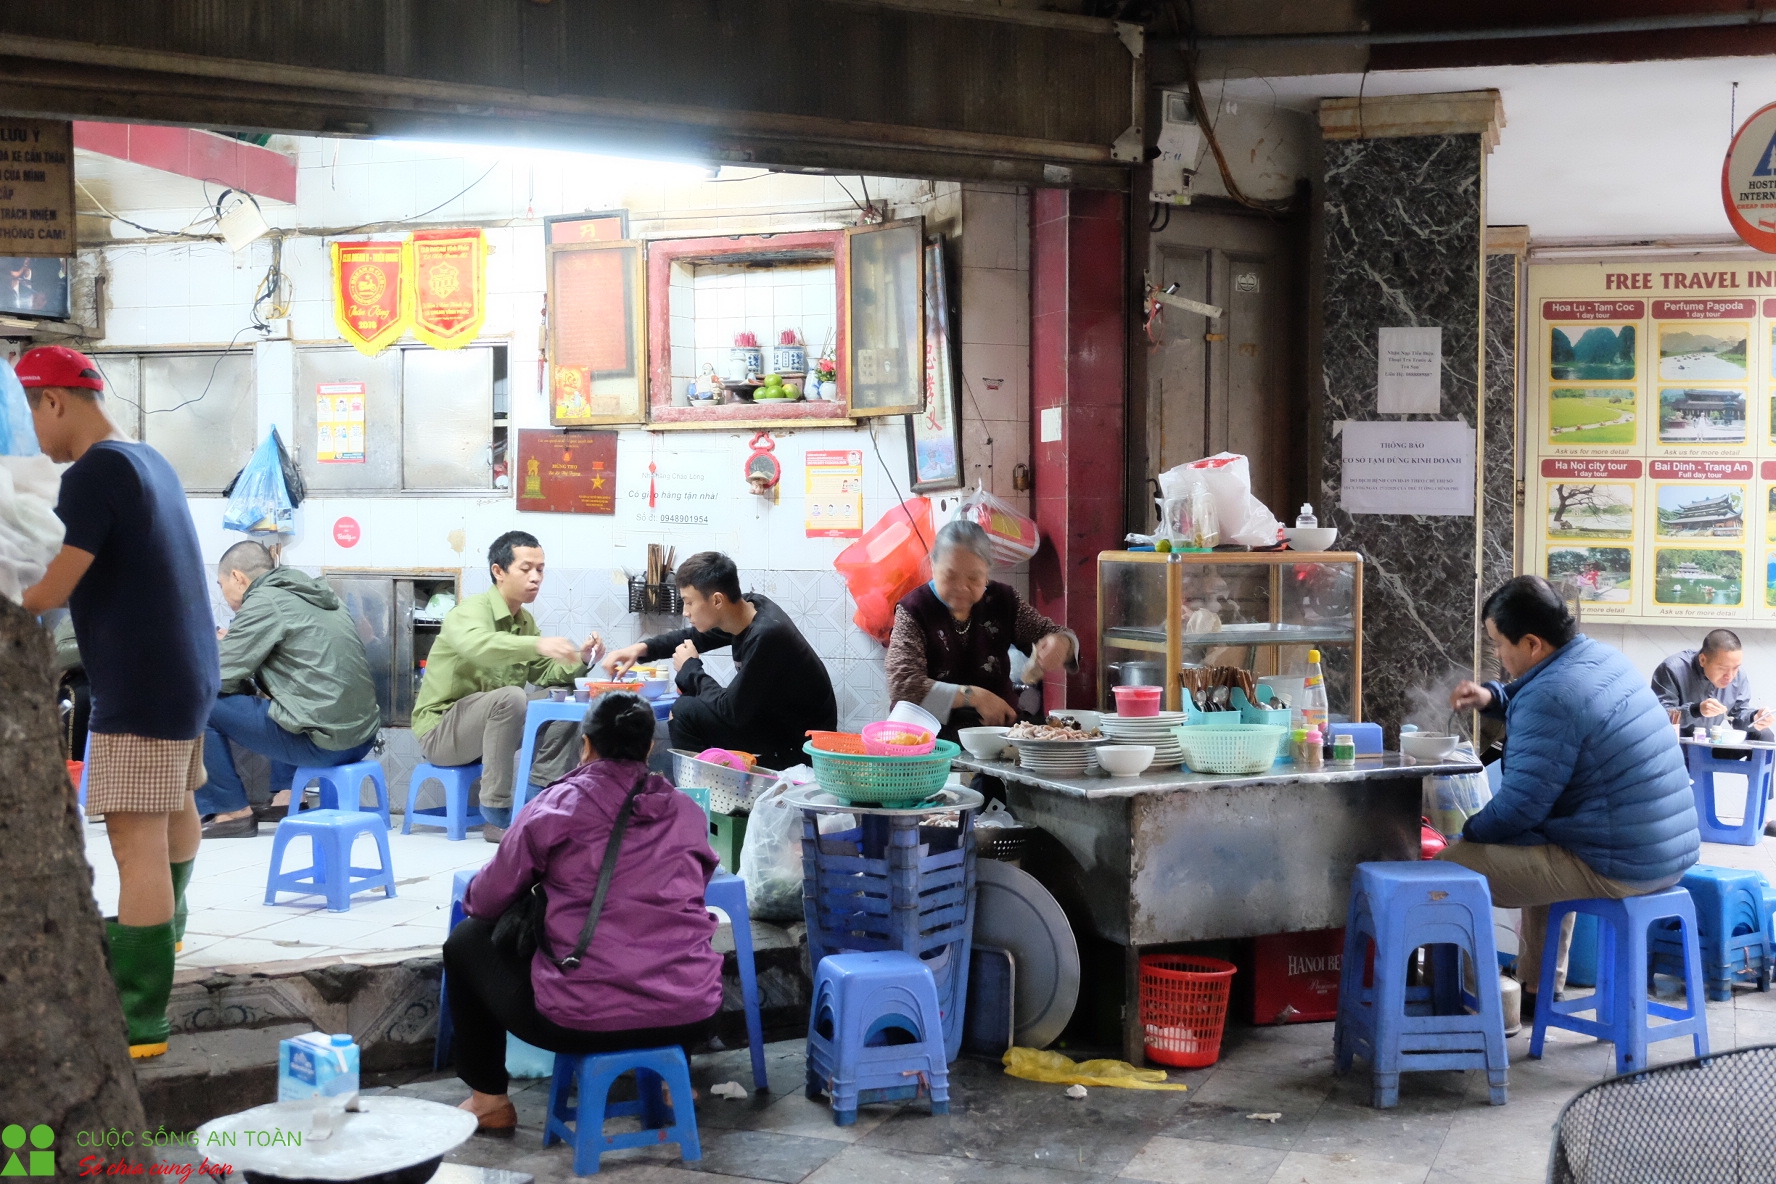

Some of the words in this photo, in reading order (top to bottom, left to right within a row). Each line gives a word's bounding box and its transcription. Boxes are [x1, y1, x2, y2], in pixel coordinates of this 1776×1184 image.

[1740, 192, 1776, 201] INTERN
[1605, 272, 1653, 290] FREE
[1660, 272, 1740, 289] TRAVEL
[1748, 270, 1776, 288] IN
[1552, 304, 1570, 312] Hoa
[1594, 303, 1613, 311] Tam
[1616, 303, 1634, 311] Coc
[1664, 302, 1704, 311] Perfume
[1706, 302, 1744, 312] Pagoda
[1555, 461, 1568, 470] Ha
[1570, 461, 1586, 470] Noi
[1588, 462, 1605, 471] city
[1655, 462, 1670, 470] Bai
[1673, 462, 1695, 471] Dinh
[1704, 462, 1731, 472] Trang
[1733, 463, 1748, 471] An
[642, 491, 658, 500] gio
[661, 491, 681, 501] hàng
[684, 492, 697, 500] tận
[660, 514, 708, 523] 0948901954
[1288, 955, 1325, 976] HANOI
